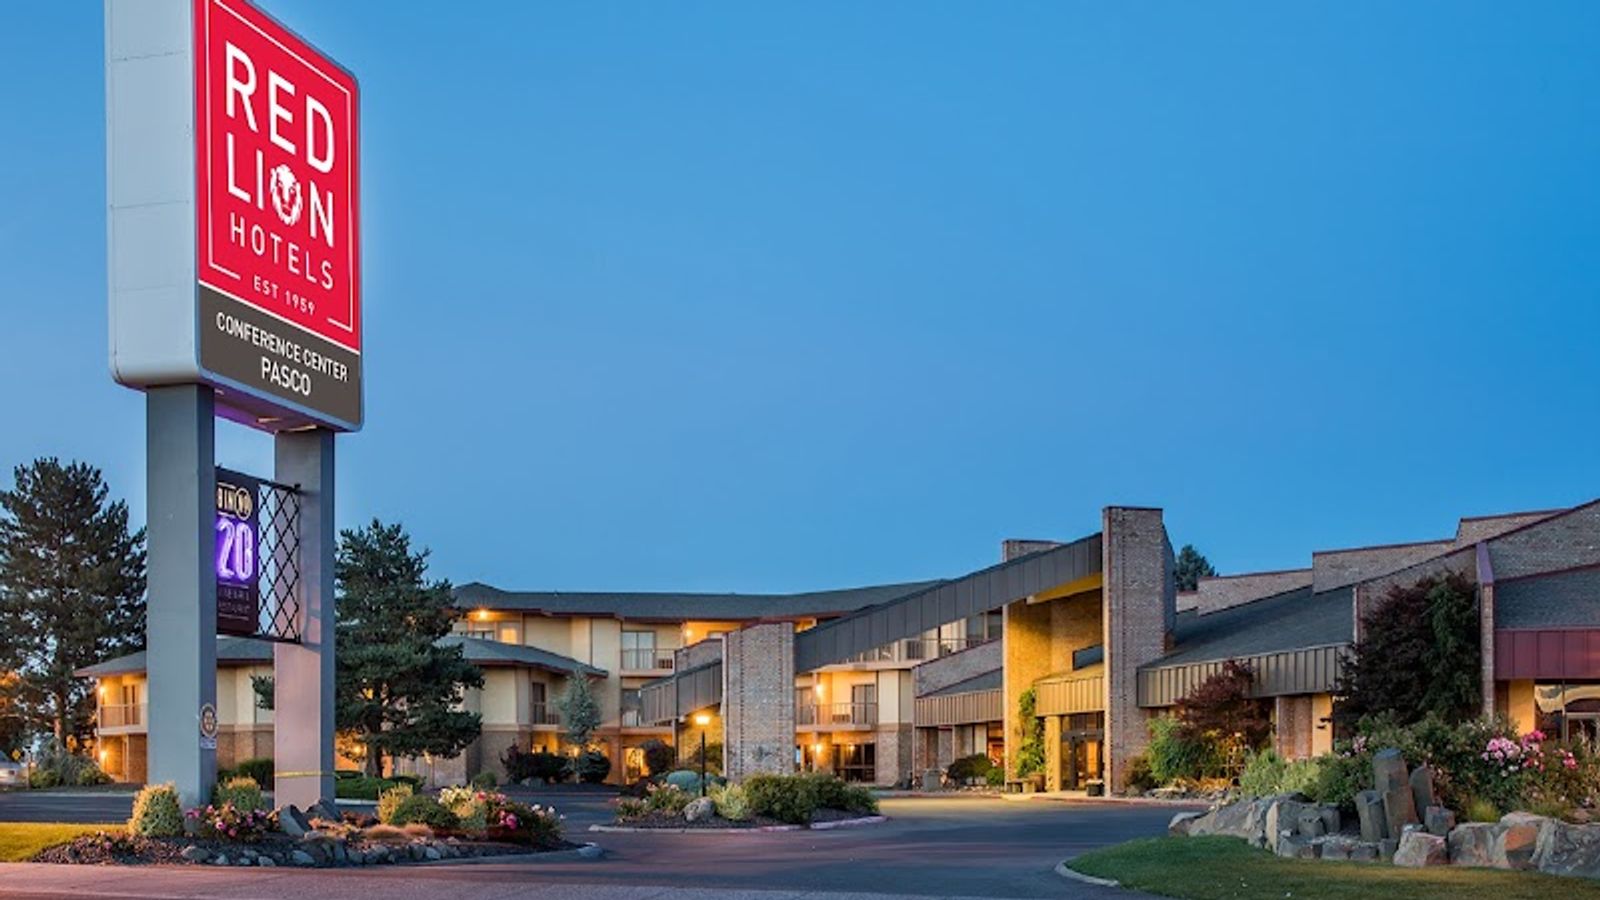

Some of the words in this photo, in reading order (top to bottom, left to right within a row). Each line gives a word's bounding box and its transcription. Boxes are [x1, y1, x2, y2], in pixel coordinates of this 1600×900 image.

[225, 40, 334, 173] RED
[226, 132, 334, 248] LION
[229, 212, 334, 291] HOTELS
[253, 275, 279, 299] EST
[285, 290, 315, 316] 1959
[216, 311, 301, 364] CONFERENCE
[302, 348, 348, 383] CENTER
[261, 356, 312, 396] PASCO
